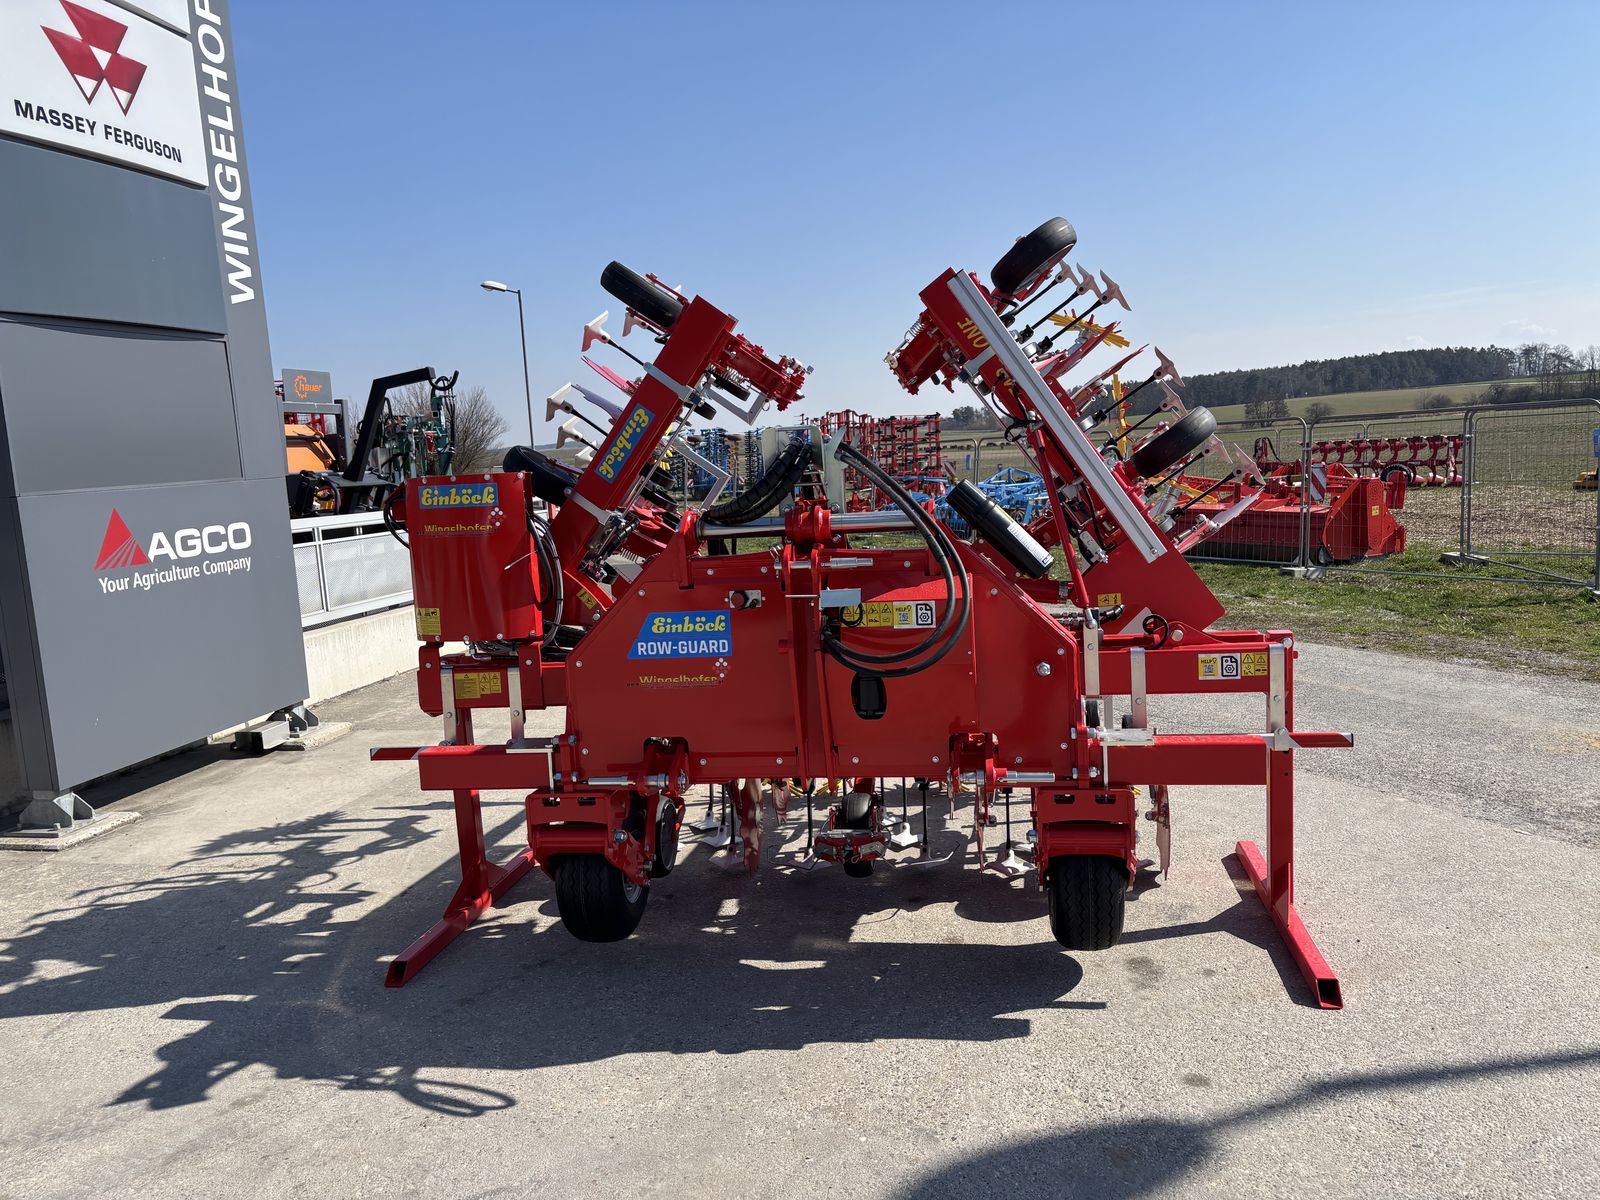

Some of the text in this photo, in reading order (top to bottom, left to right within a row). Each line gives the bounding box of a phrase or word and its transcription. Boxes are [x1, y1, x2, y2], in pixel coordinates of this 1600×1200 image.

[14, 99, 183, 163] MASSEY FERGUSON
[599, 407, 650, 481] Einböck
[421, 486, 496, 506] Einböck
[147, 521, 252, 562] AGCO
[98, 556, 251, 594] Your Agriculture Company
[651, 615, 726, 634] Einböck
[637, 639, 729, 656] ROW-GUARD
